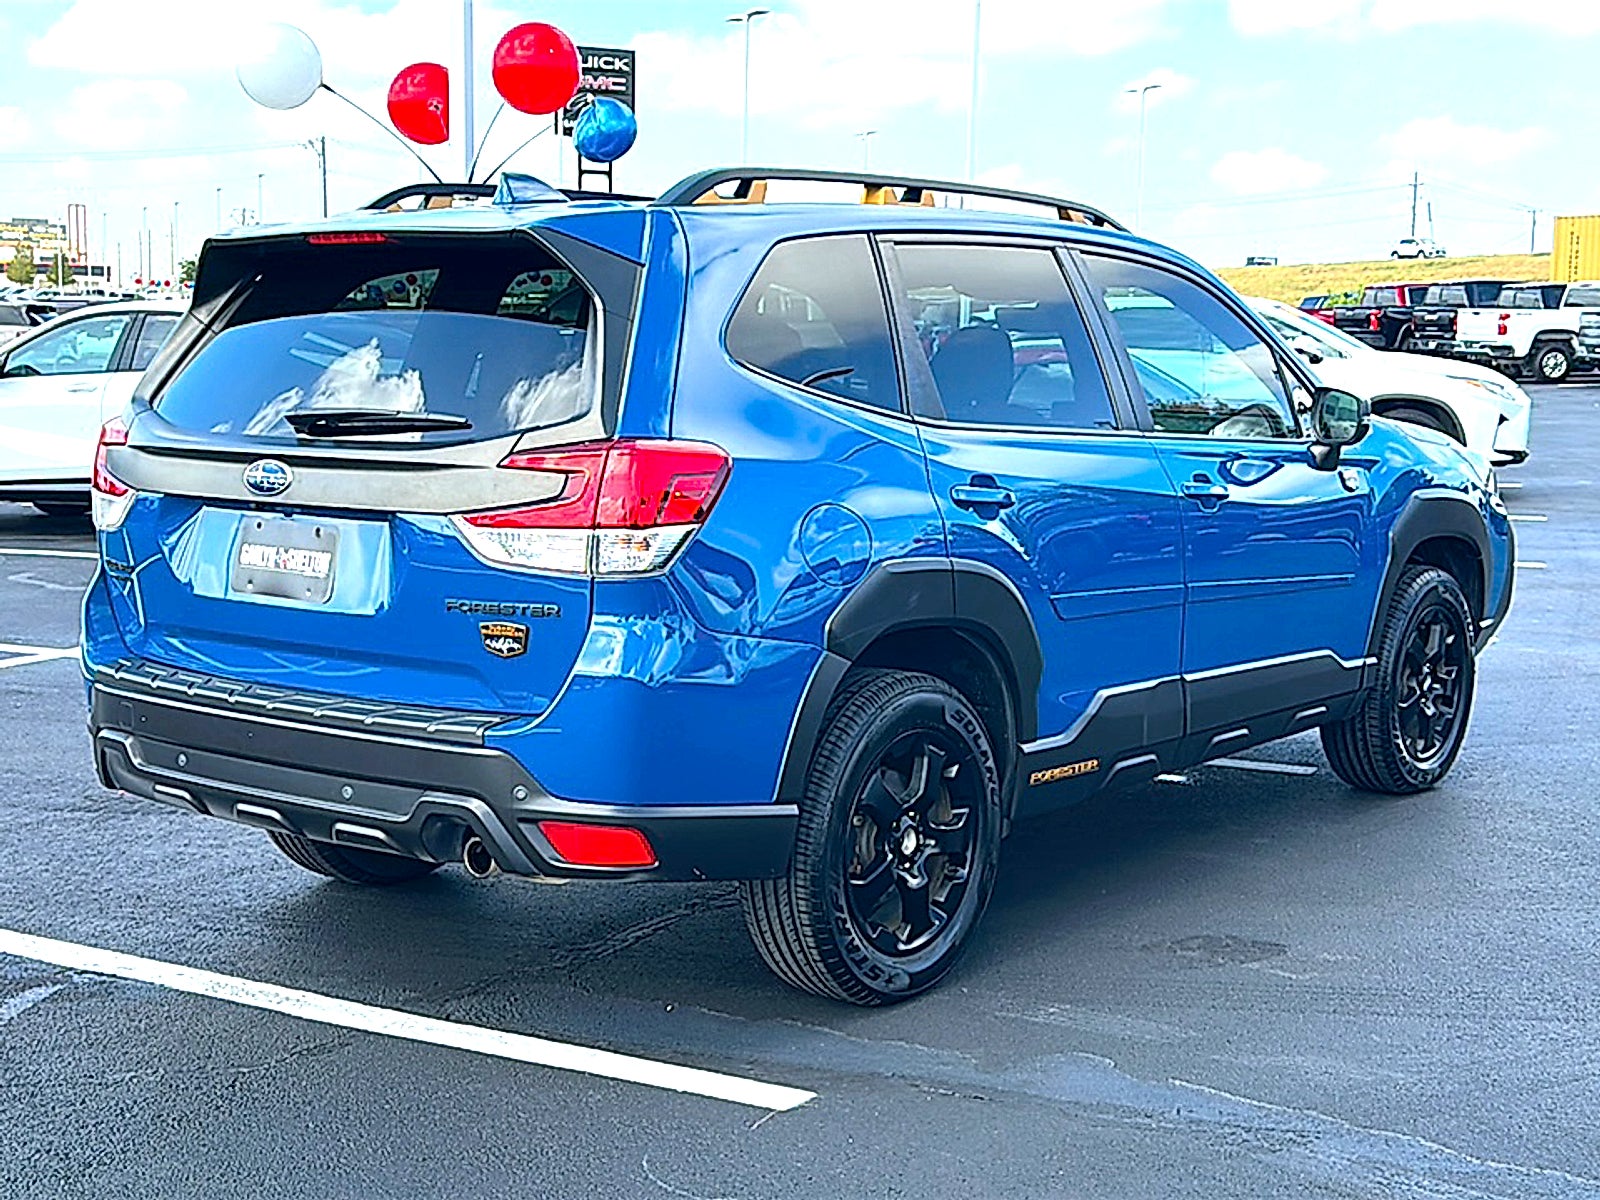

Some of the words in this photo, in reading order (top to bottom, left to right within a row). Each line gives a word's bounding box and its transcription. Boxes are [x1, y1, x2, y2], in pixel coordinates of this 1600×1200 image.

[580, 55, 630, 71] UICK
[445, 598, 561, 618] FORESTER
[1029, 759, 1100, 786] FORESTER
